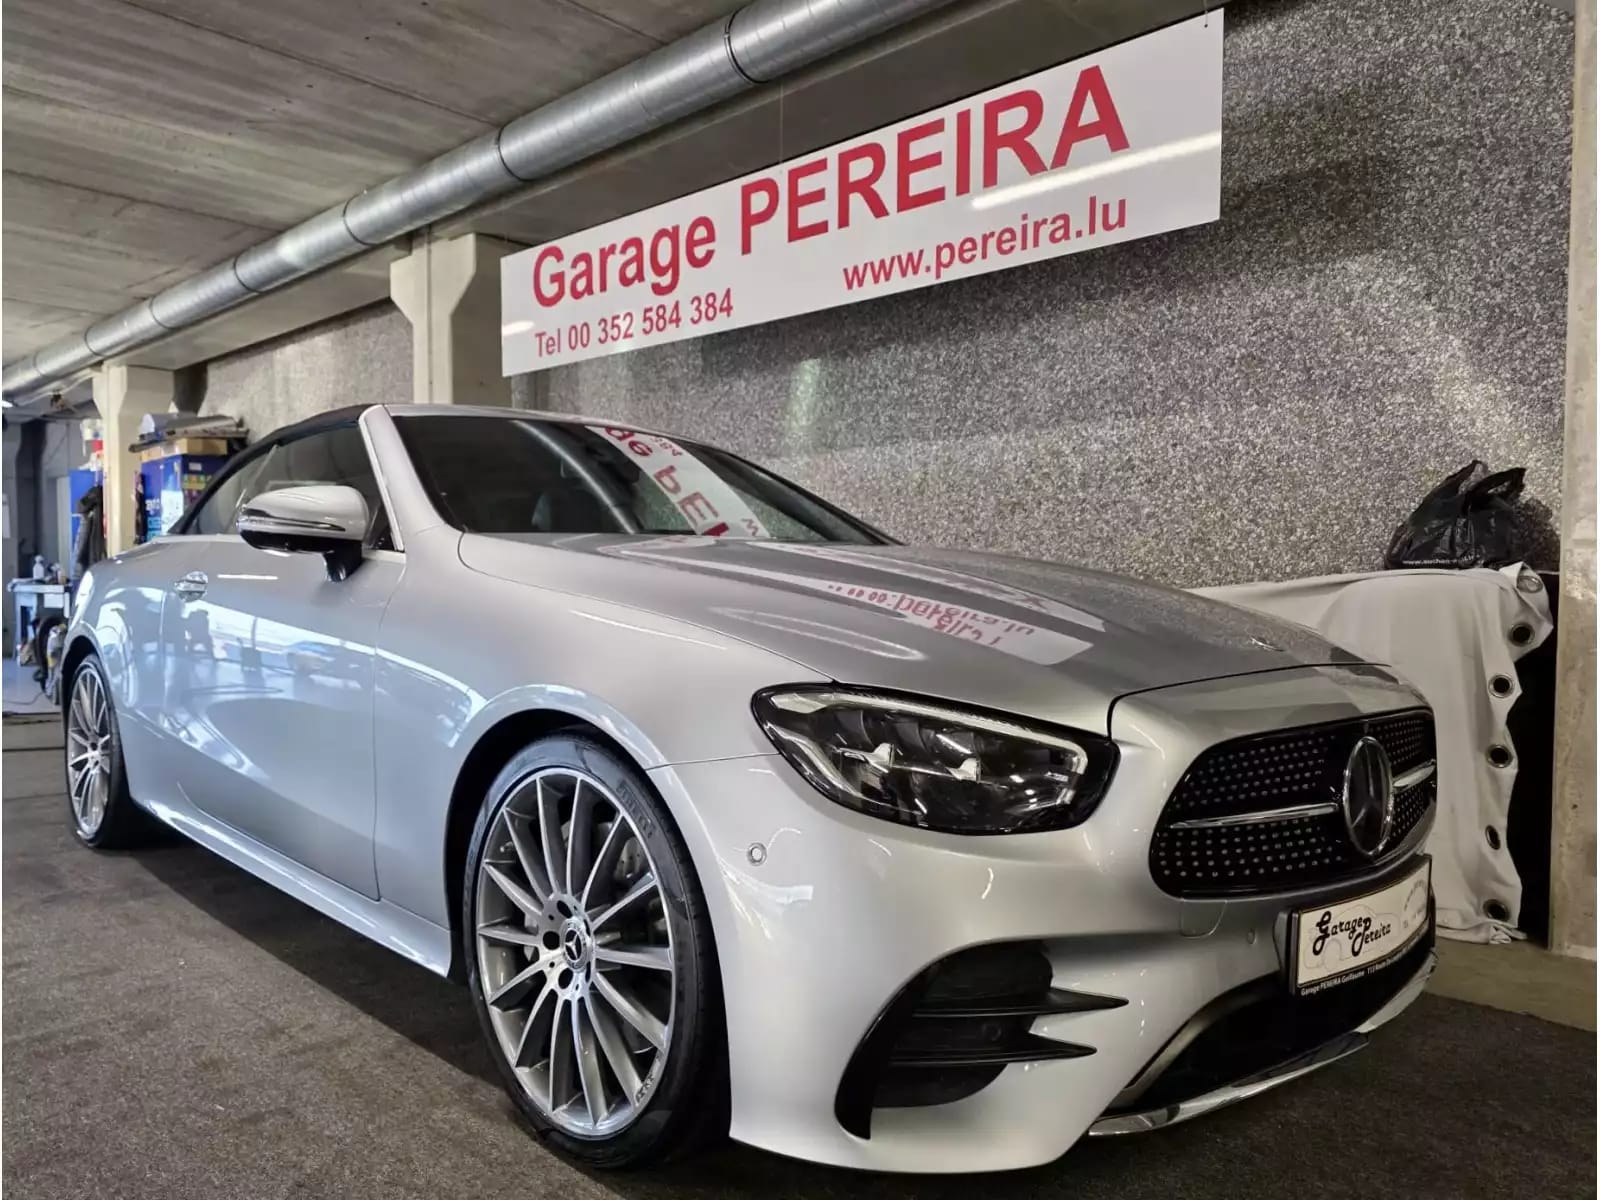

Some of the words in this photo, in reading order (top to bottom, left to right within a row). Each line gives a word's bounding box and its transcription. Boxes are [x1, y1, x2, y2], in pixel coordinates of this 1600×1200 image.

[533, 215, 717, 309] Garage
[740, 63, 1131, 257] PEREIRA
[842, 195, 1128, 292] www.pereira.lu
[534, 328, 562, 358] Tel
[567, 321, 591, 352] 00
[597, 311, 634, 345] 352
[641, 300, 682, 336] 584
[689, 287, 734, 325] 384
[1312, 910, 1363, 956] Garage
[1351, 916, 1391, 957] Pereira
